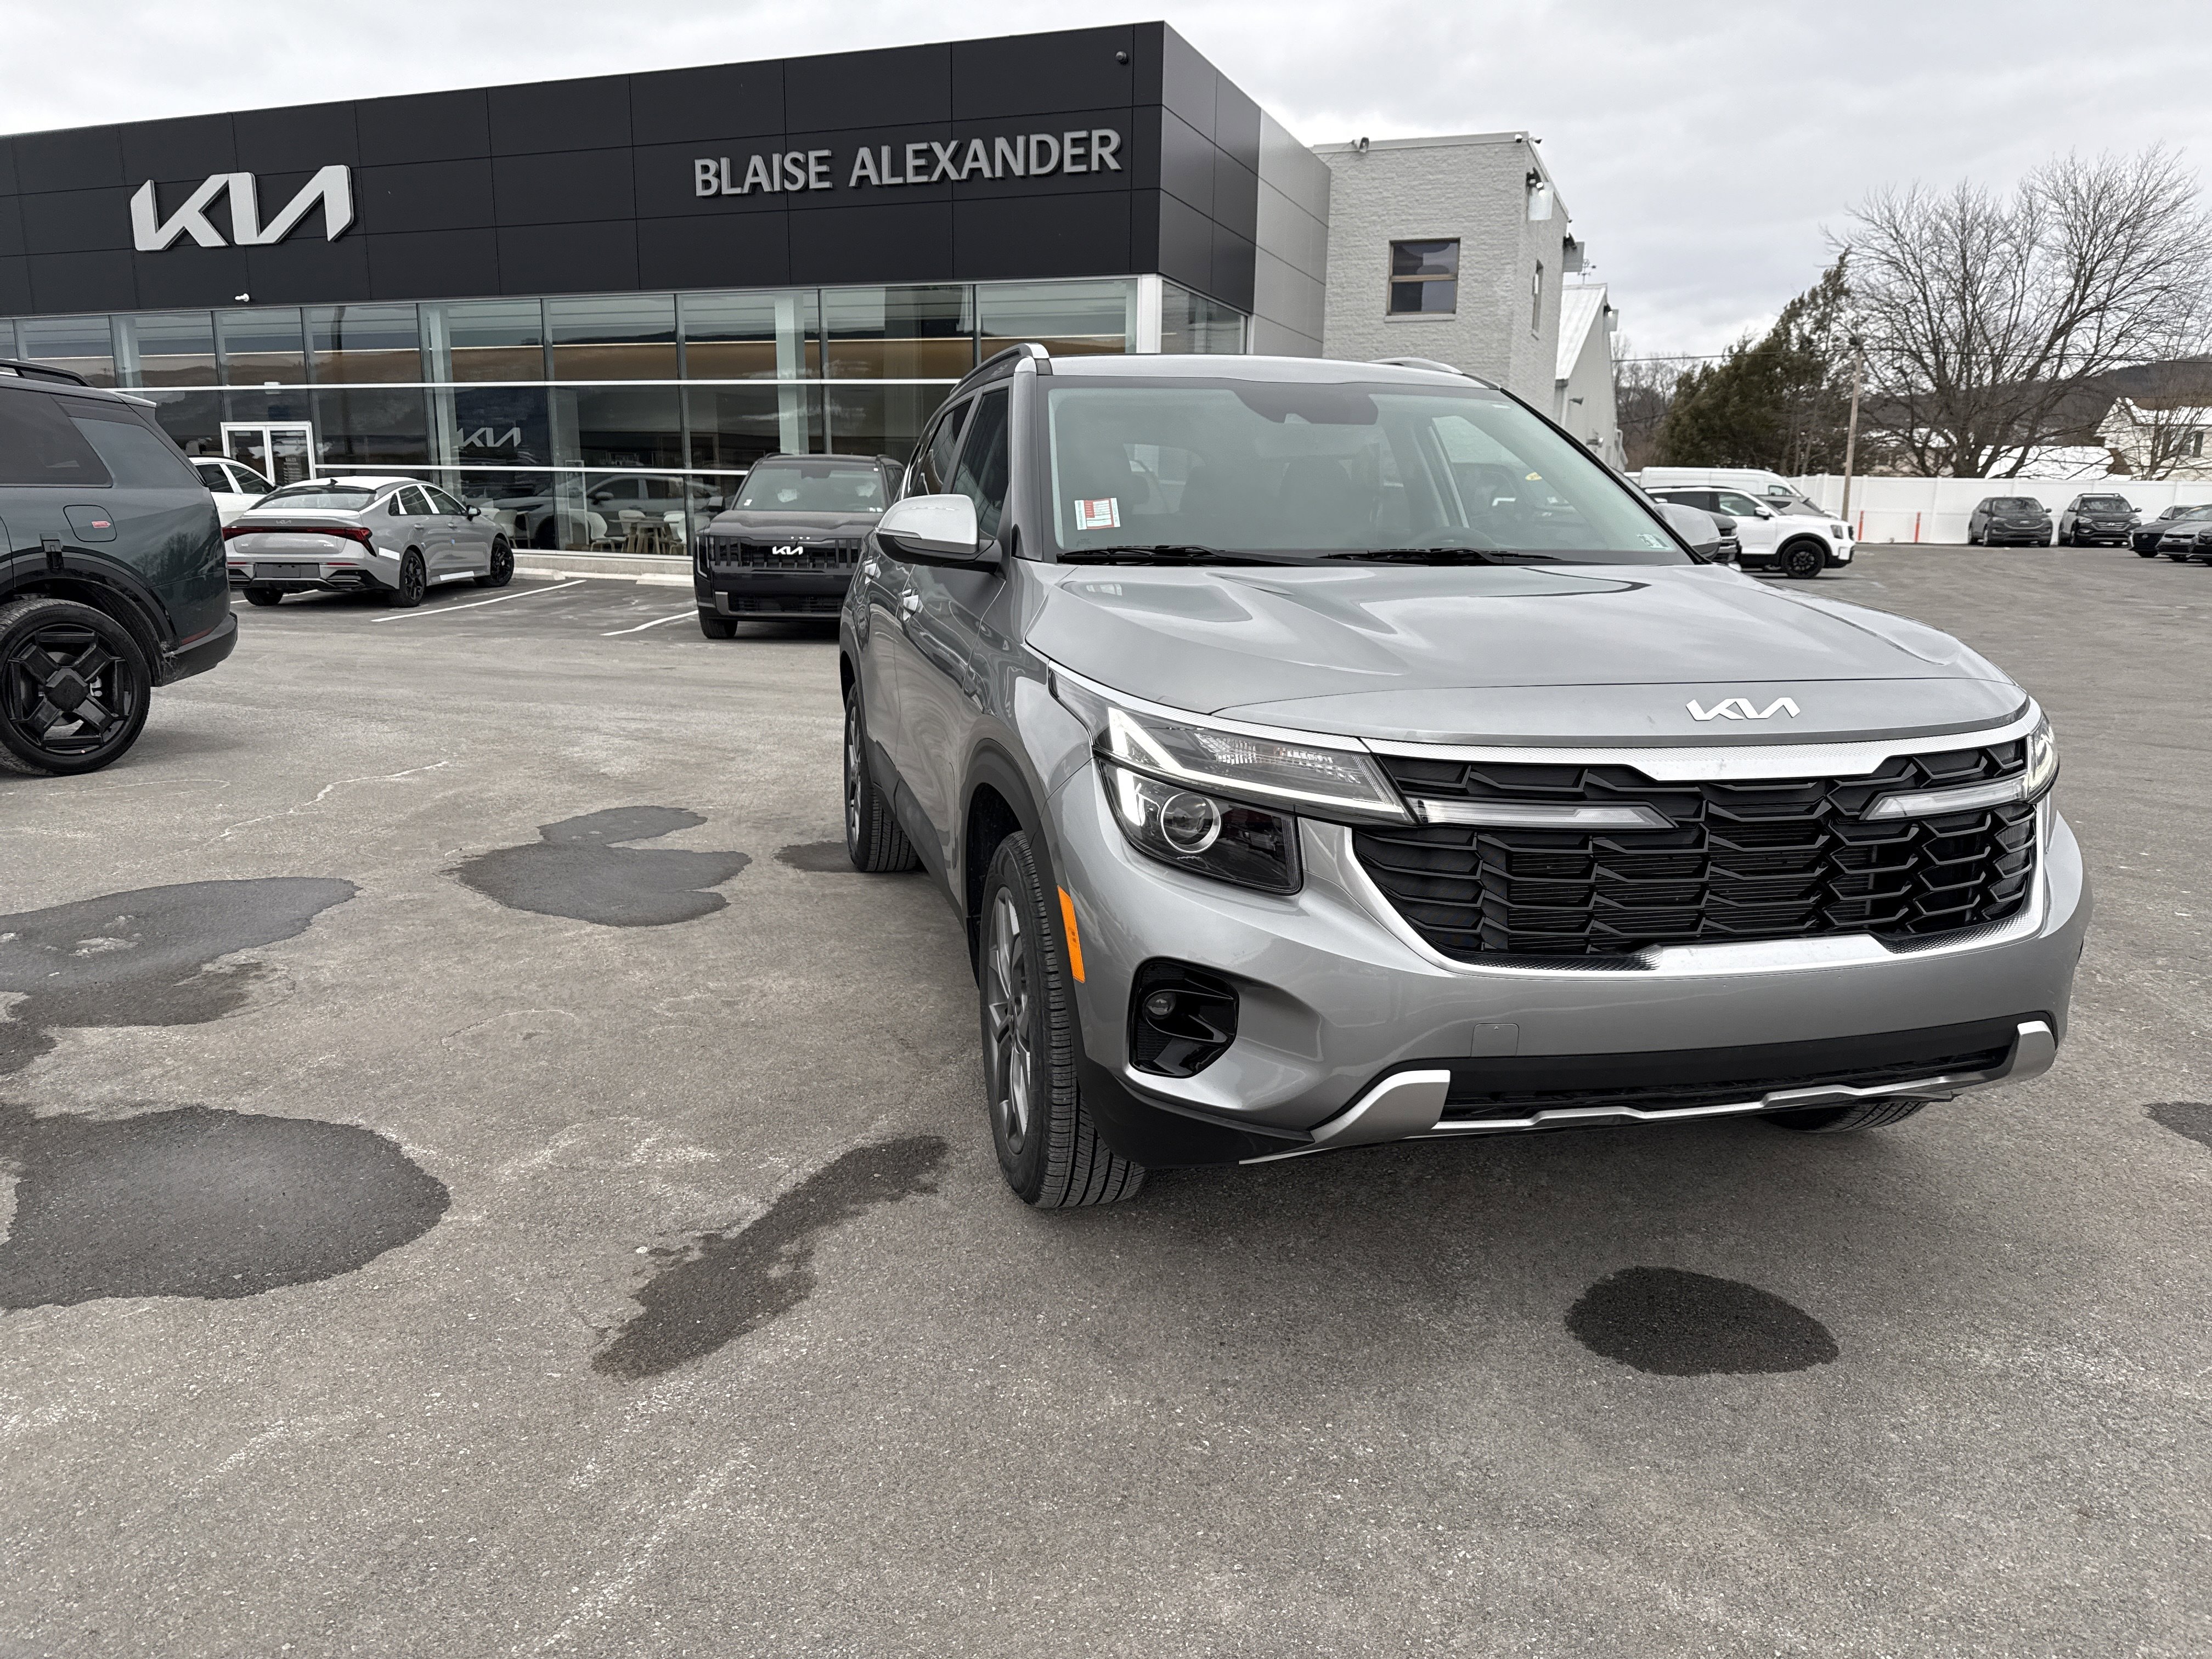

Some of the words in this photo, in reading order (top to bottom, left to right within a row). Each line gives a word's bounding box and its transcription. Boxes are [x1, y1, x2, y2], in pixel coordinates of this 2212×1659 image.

[694, 149, 833, 197] BLAISE
[849, 128, 1122, 188] ALEXANDER
[130, 165, 354, 252] KIA
[456, 427, 521, 447] KIA
[772, 546, 803, 555] KIA
[1685, 697, 1801, 721] KIA
